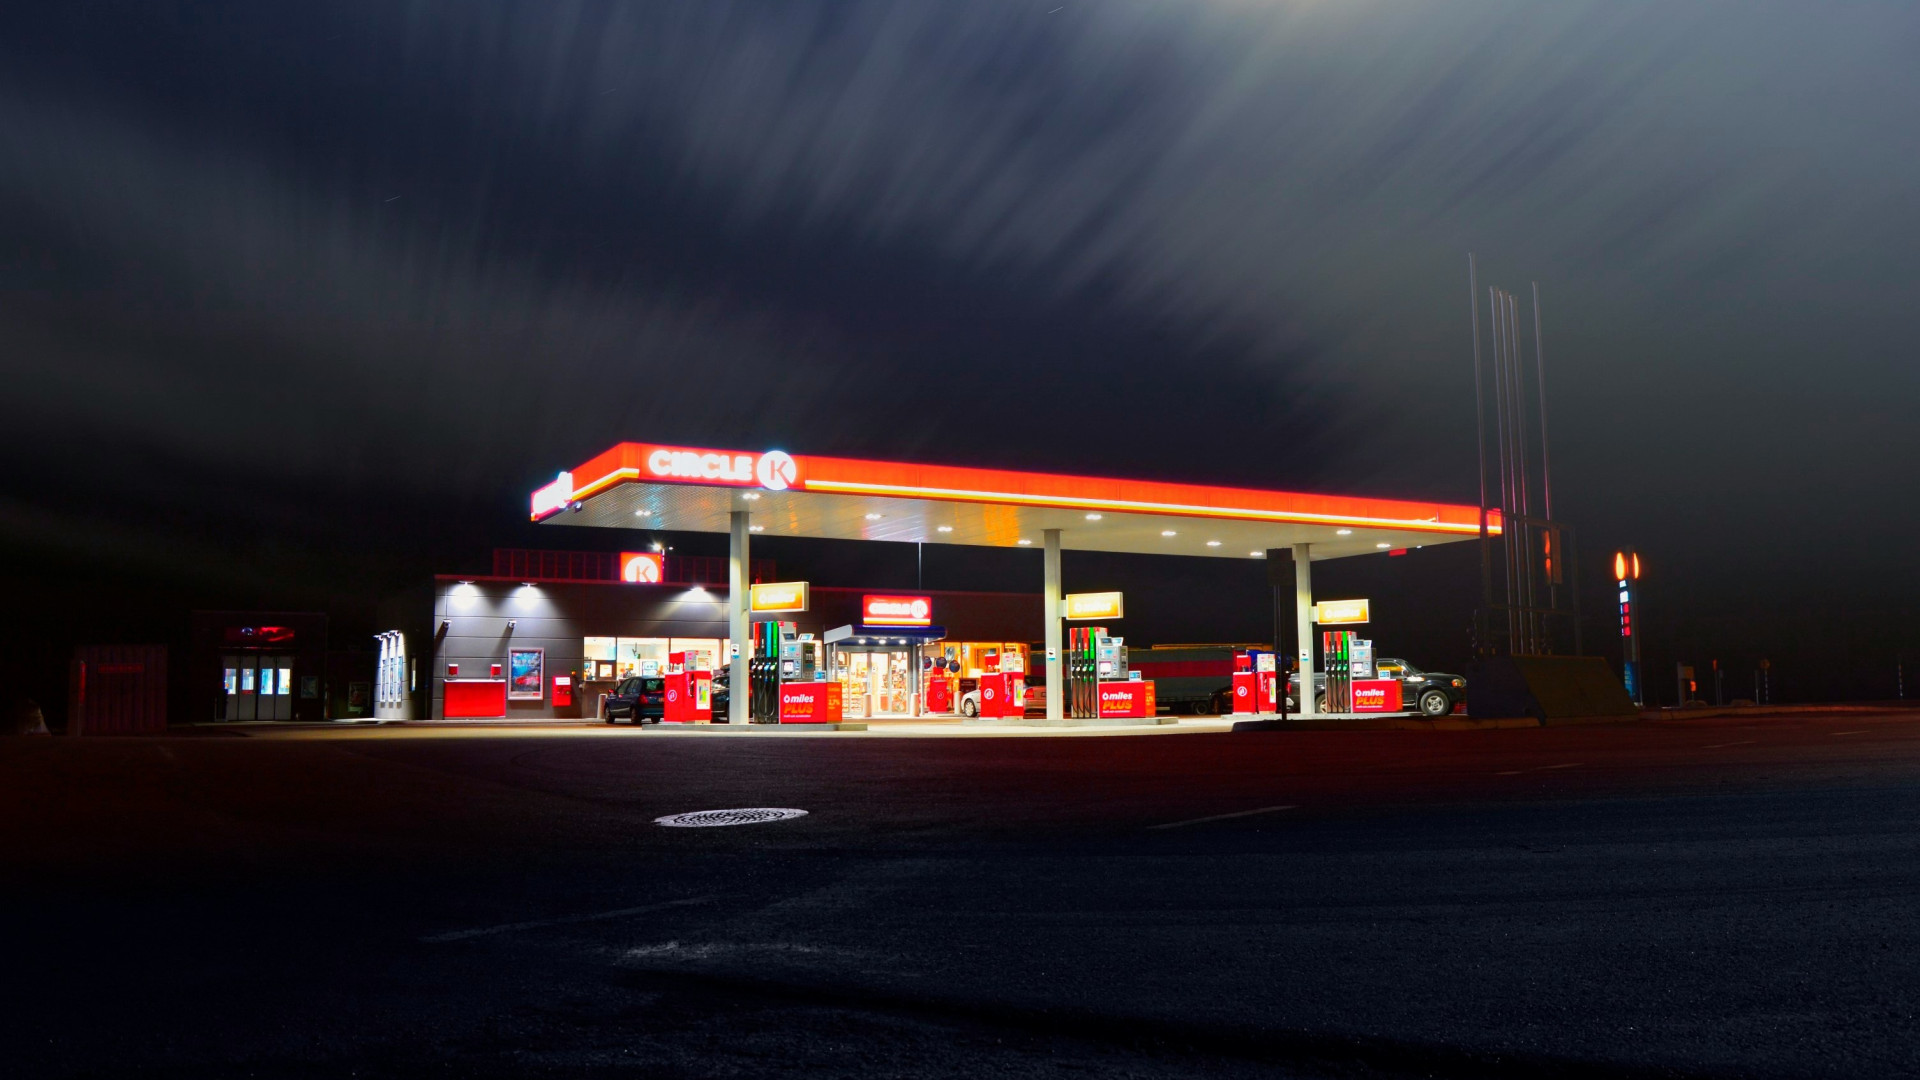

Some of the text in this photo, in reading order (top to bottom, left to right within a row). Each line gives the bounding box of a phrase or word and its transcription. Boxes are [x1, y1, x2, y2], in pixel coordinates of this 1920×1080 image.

[649, 450, 752, 480] CIRCLE
[790, 694, 814, 703] miles
[1110, 691, 1132, 700] miles
[1103, 701, 1132, 709] PLUS
[1356, 697, 1384, 705] PLUS
[784, 704, 813, 713] PLUS
